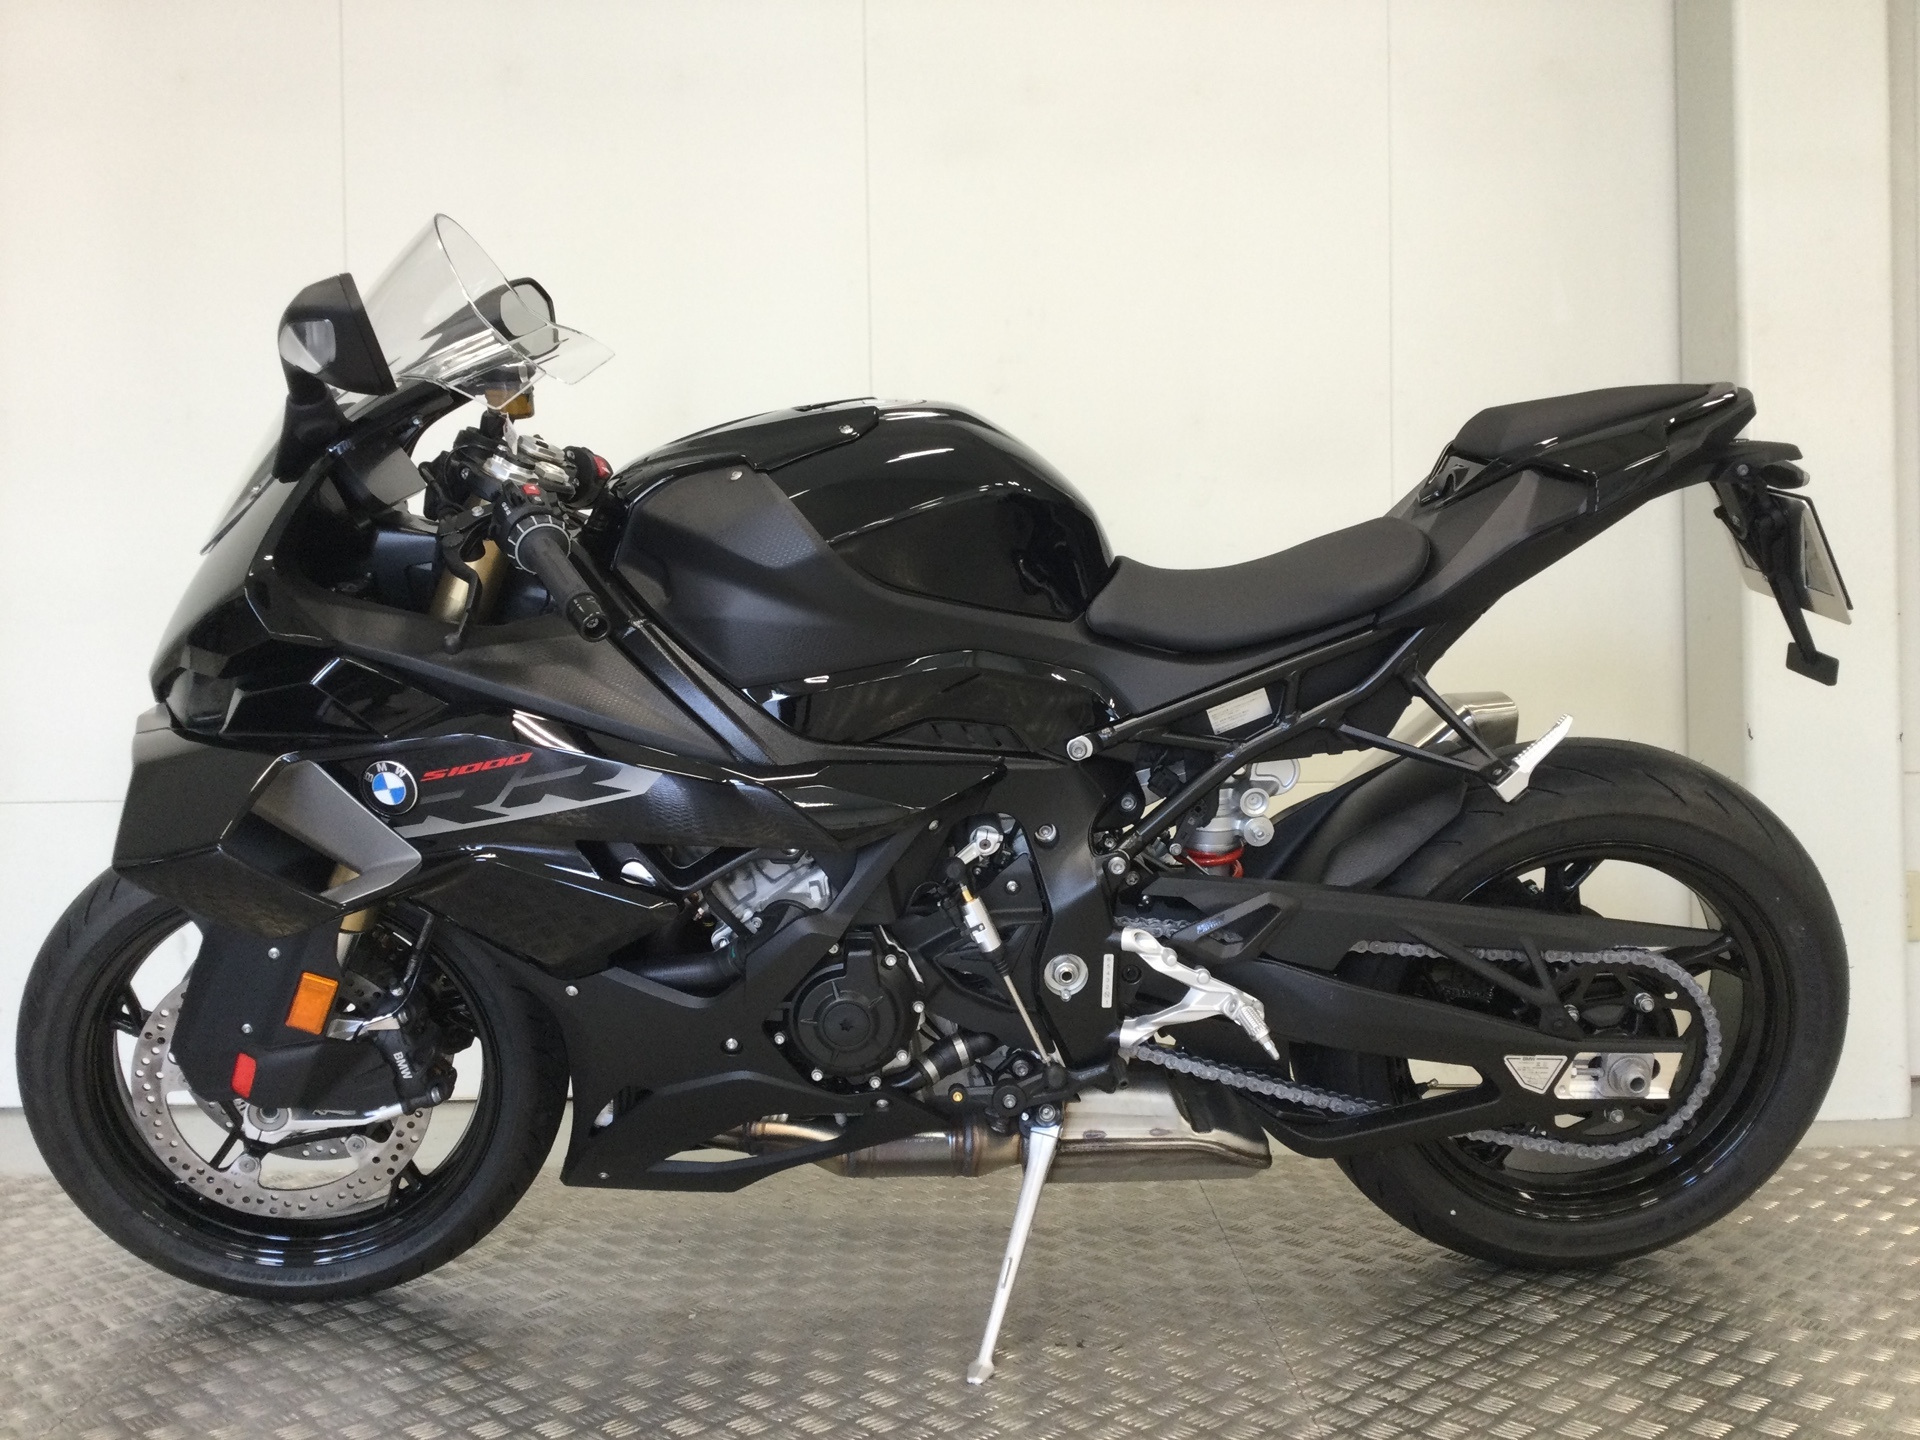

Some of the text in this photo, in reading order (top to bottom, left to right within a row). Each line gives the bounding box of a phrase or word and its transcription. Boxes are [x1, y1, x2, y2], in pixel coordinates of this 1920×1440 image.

[364, 762, 407, 783] BMW
[420, 752, 533, 782] S1000
[393, 1051, 413, 1079] BMW
